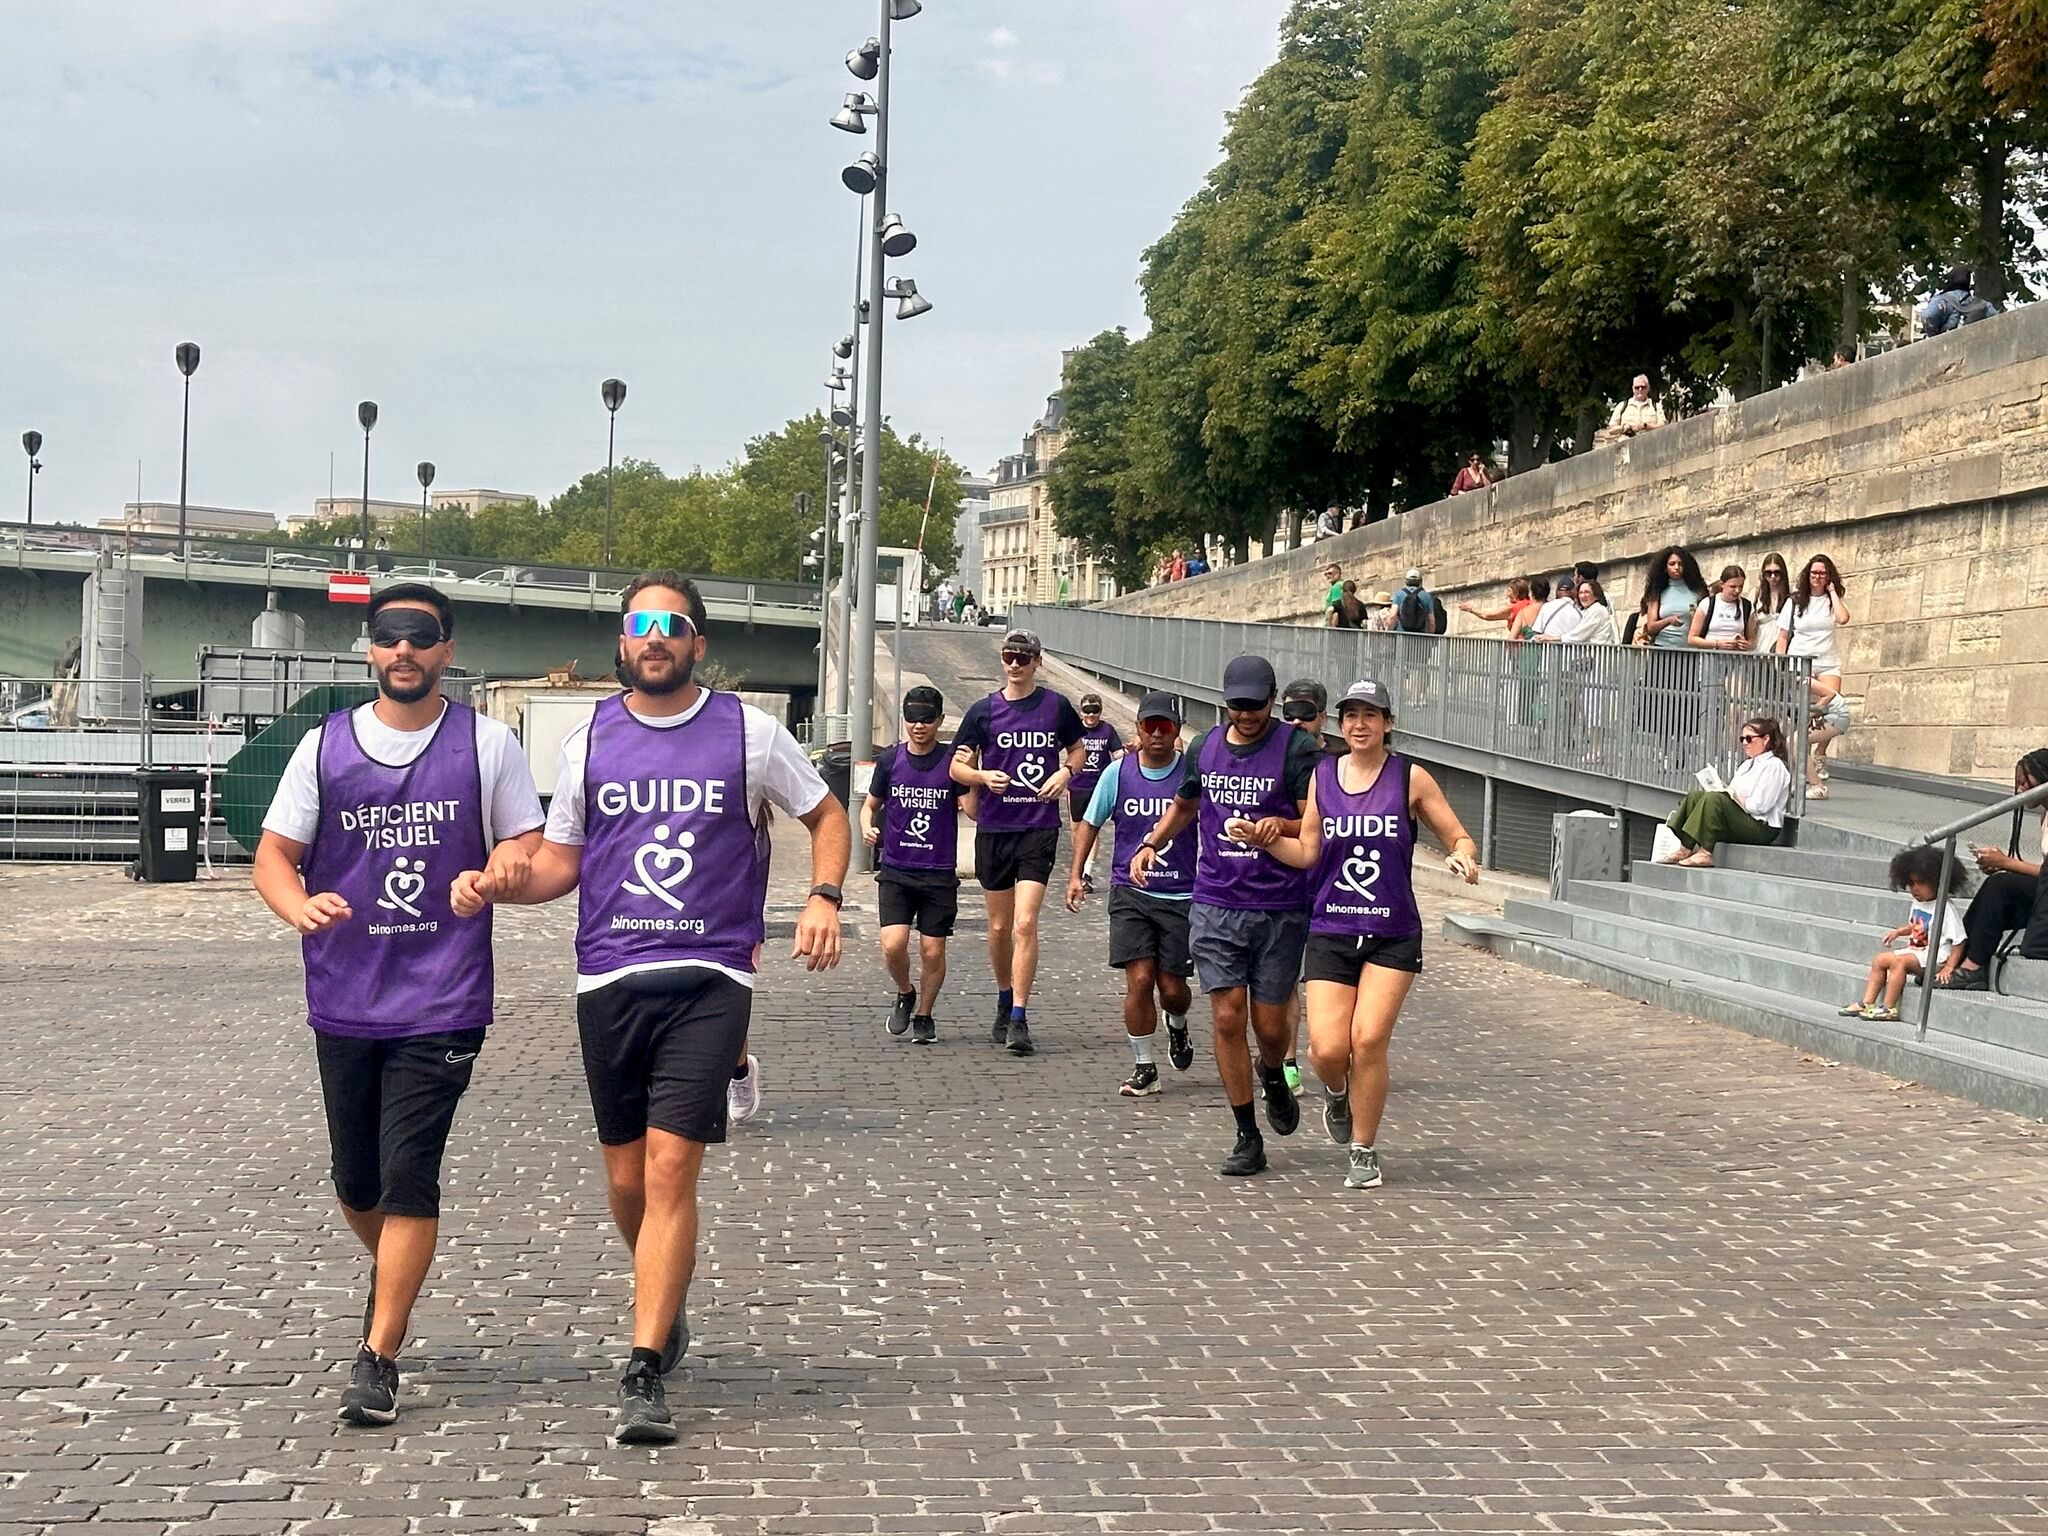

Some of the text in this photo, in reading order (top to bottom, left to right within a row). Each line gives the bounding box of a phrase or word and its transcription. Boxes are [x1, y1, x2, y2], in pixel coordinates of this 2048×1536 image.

[997, 731, 1056, 749] GUIDE
[1200, 771, 1275, 792] DÉFICIENT
[597, 778, 726, 816] GUIDE
[891, 784, 949, 800] DÉFICIENT
[1208, 789, 1260, 806] VISUEL
[899, 797, 939, 810] VISUEL
[340, 800, 460, 831] DÉFICIENT
[363, 824, 441, 850] VISUEL
[1322, 815, 1399, 840] GUIDE
[1325, 902, 1391, 918] binomes.org
[367, 920, 438, 936] binomes.org
[610, 914, 705, 935] binomes.org
